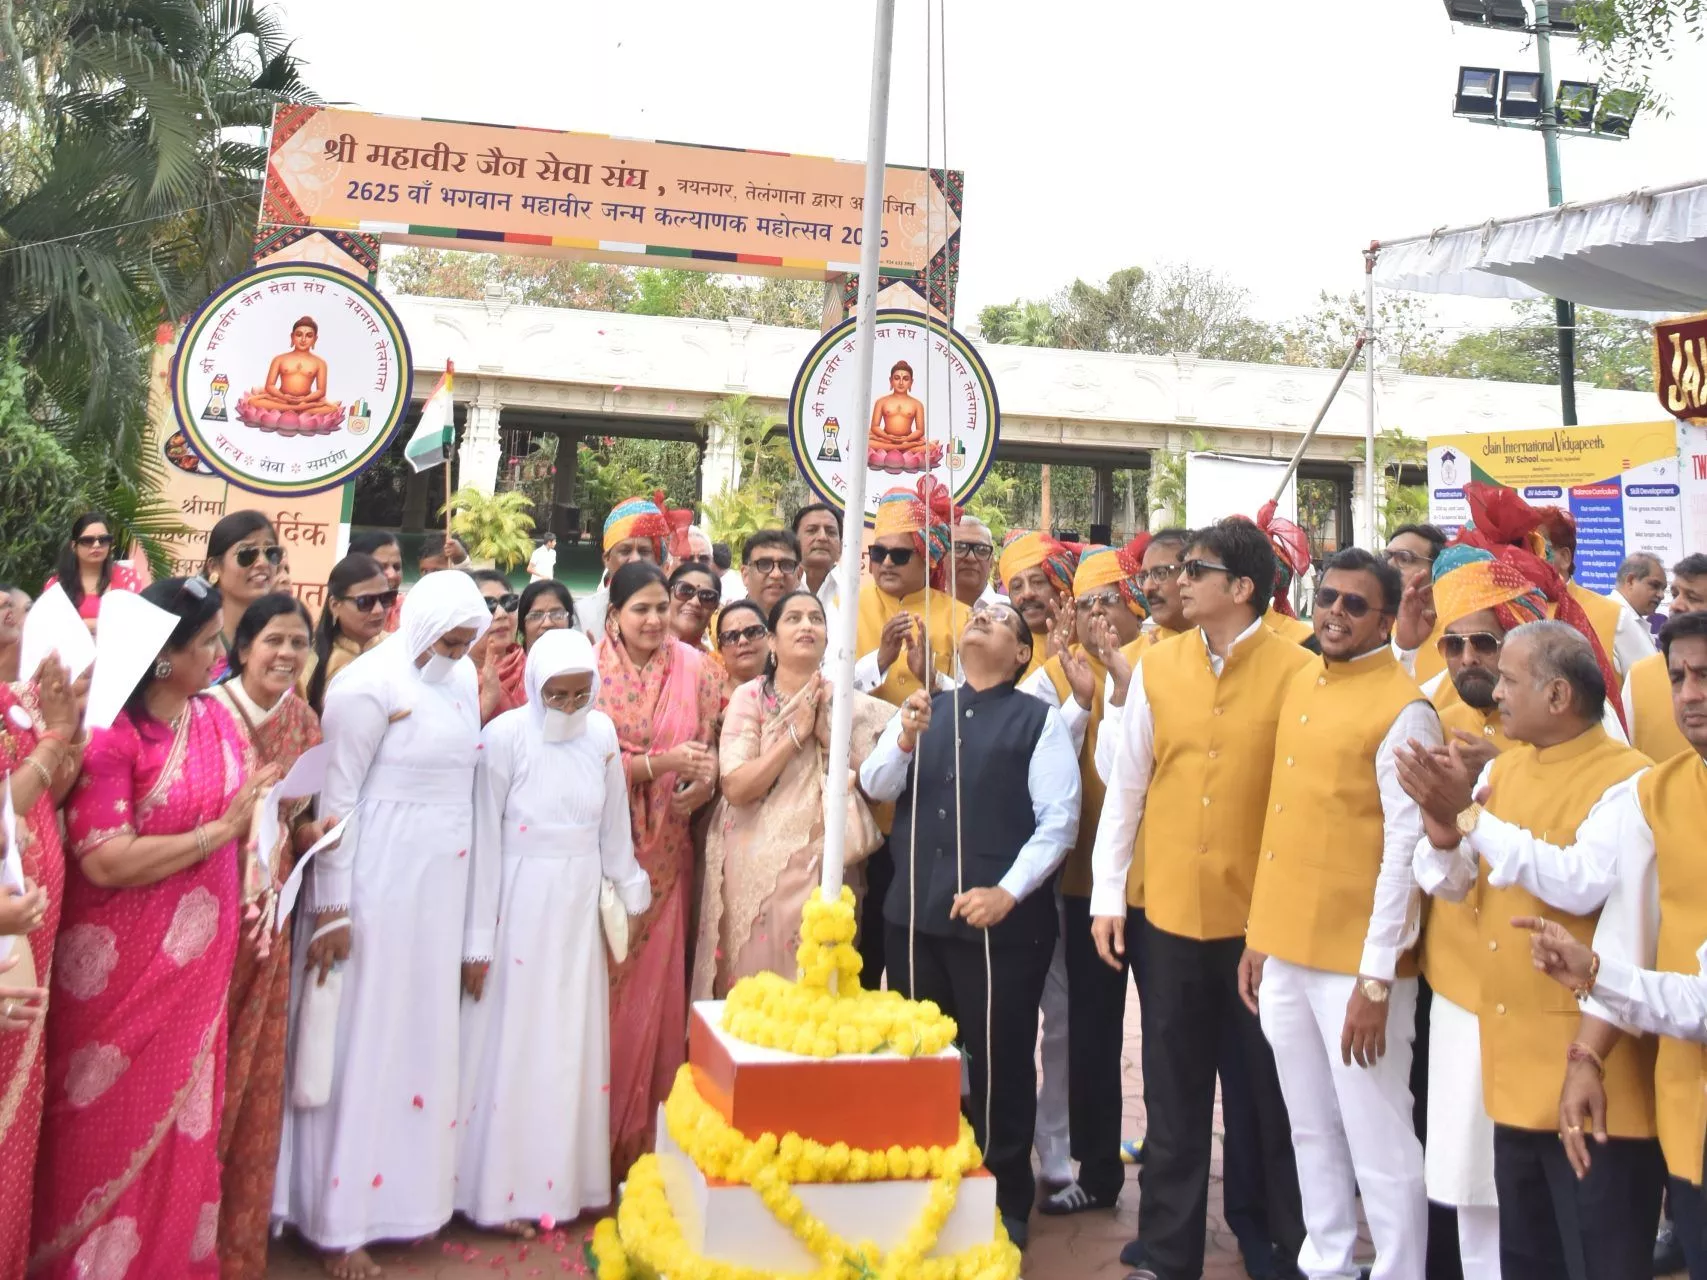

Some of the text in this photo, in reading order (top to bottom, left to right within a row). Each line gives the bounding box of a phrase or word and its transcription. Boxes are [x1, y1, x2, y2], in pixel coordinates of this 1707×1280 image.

[323, 133, 358, 165] श्री
[366, 140, 468, 174] महावीर
[476, 146, 528, 180] जैन
[535, 151, 593, 186] सेवा
[745, 180, 806, 206] तेलंगाना
[812, 192, 843, 211] द्वारा
[346, 179, 889, 249] 2625 वाँ भगवान महावीर जन्म कल्याणक महोत्सव 206
[240, 285, 263, 309] जैन
[268, 281, 297, 296] सेवा
[303, 278, 327, 296] संघ
[206, 307, 240, 352] महावीर
[344, 294, 381, 336] त्रयनगर
[896, 324, 917, 341] संघ
[199, 353, 215, 374] श्री
[373, 339, 389, 393] तेलंगाना
[817, 353, 845, 396] महावीर
[811, 401, 826, 418] श्री
[962, 380, 978, 432] तेलंगाना
[213, 431, 350, 474] सत्य सेवा समर्पण
[1482, 436, 1501, 457] Jain
[1502, 436, 1555, 455] International
[1640, 486, 1675, 497] Development
